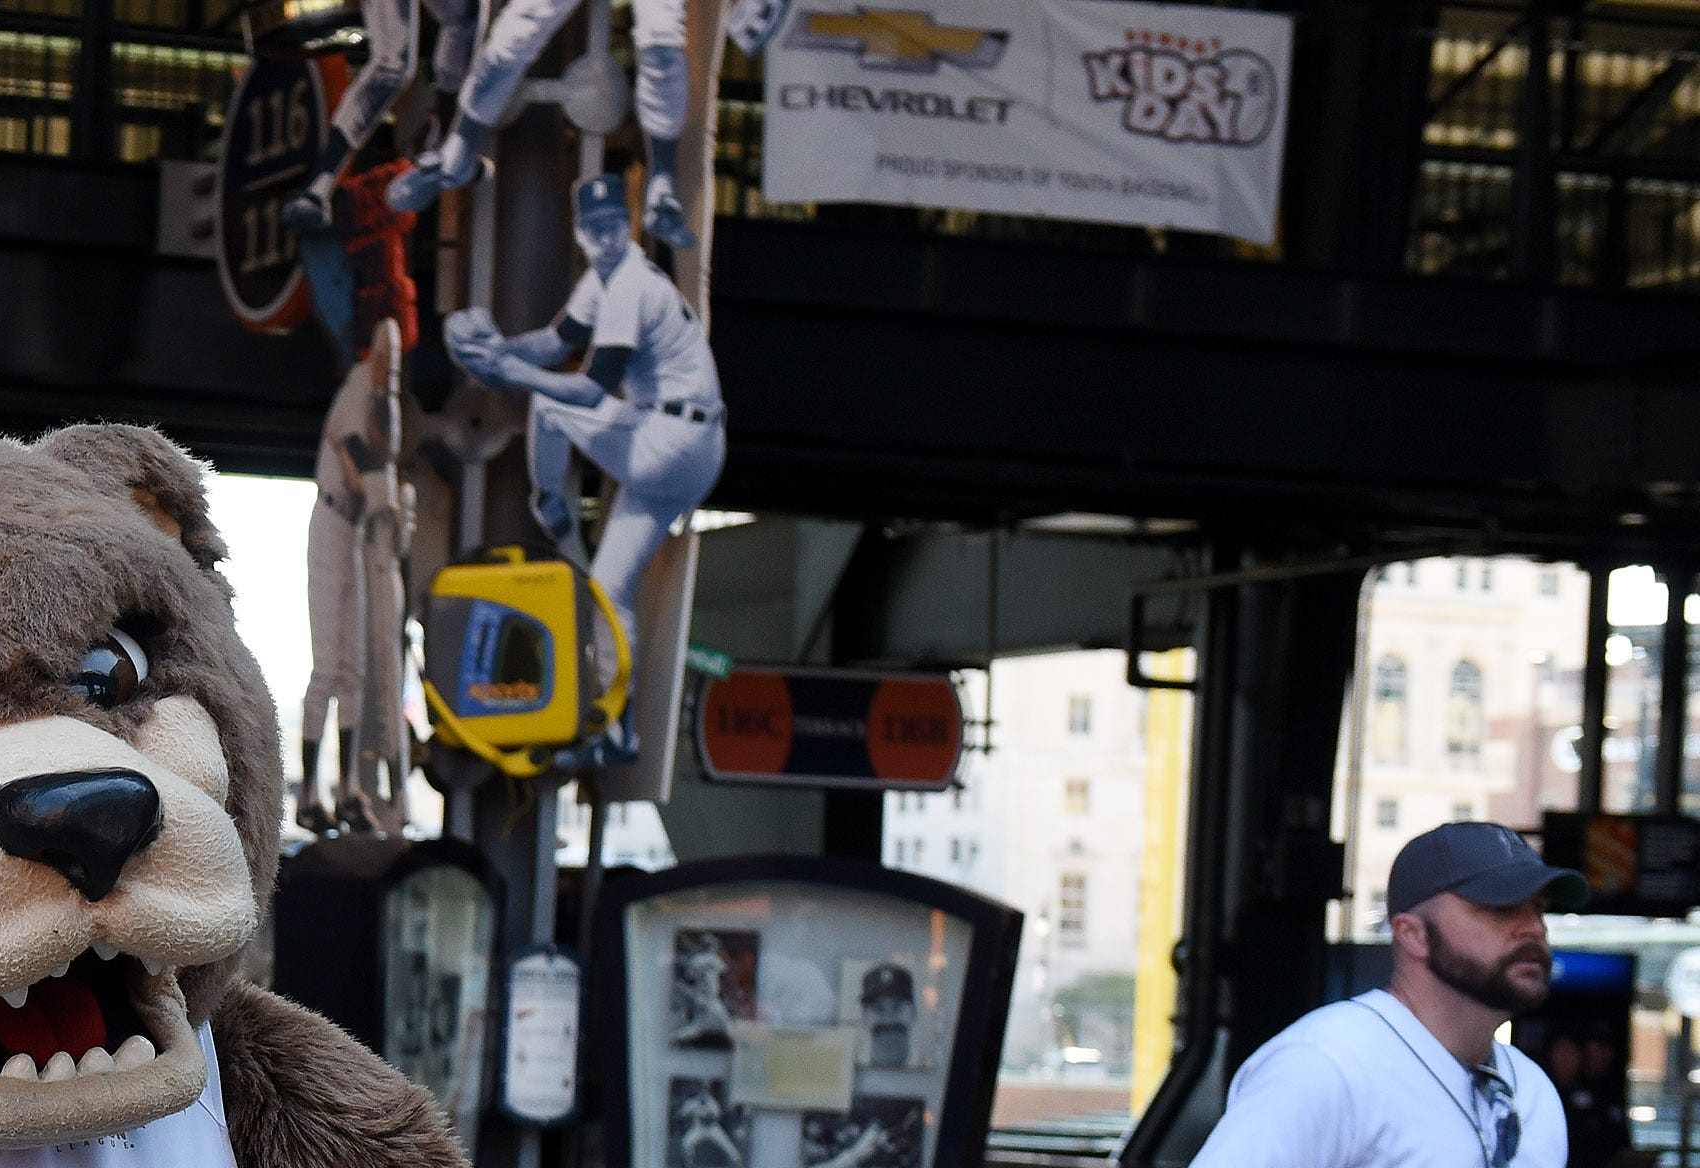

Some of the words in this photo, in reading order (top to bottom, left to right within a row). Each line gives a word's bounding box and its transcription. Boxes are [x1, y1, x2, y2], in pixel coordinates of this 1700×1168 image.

[1083, 48, 1228, 101] KIDS
[246, 77, 310, 167] 116
[778, 83, 1015, 126] CHEVROLET
[1121, 93, 1242, 142] DAY
